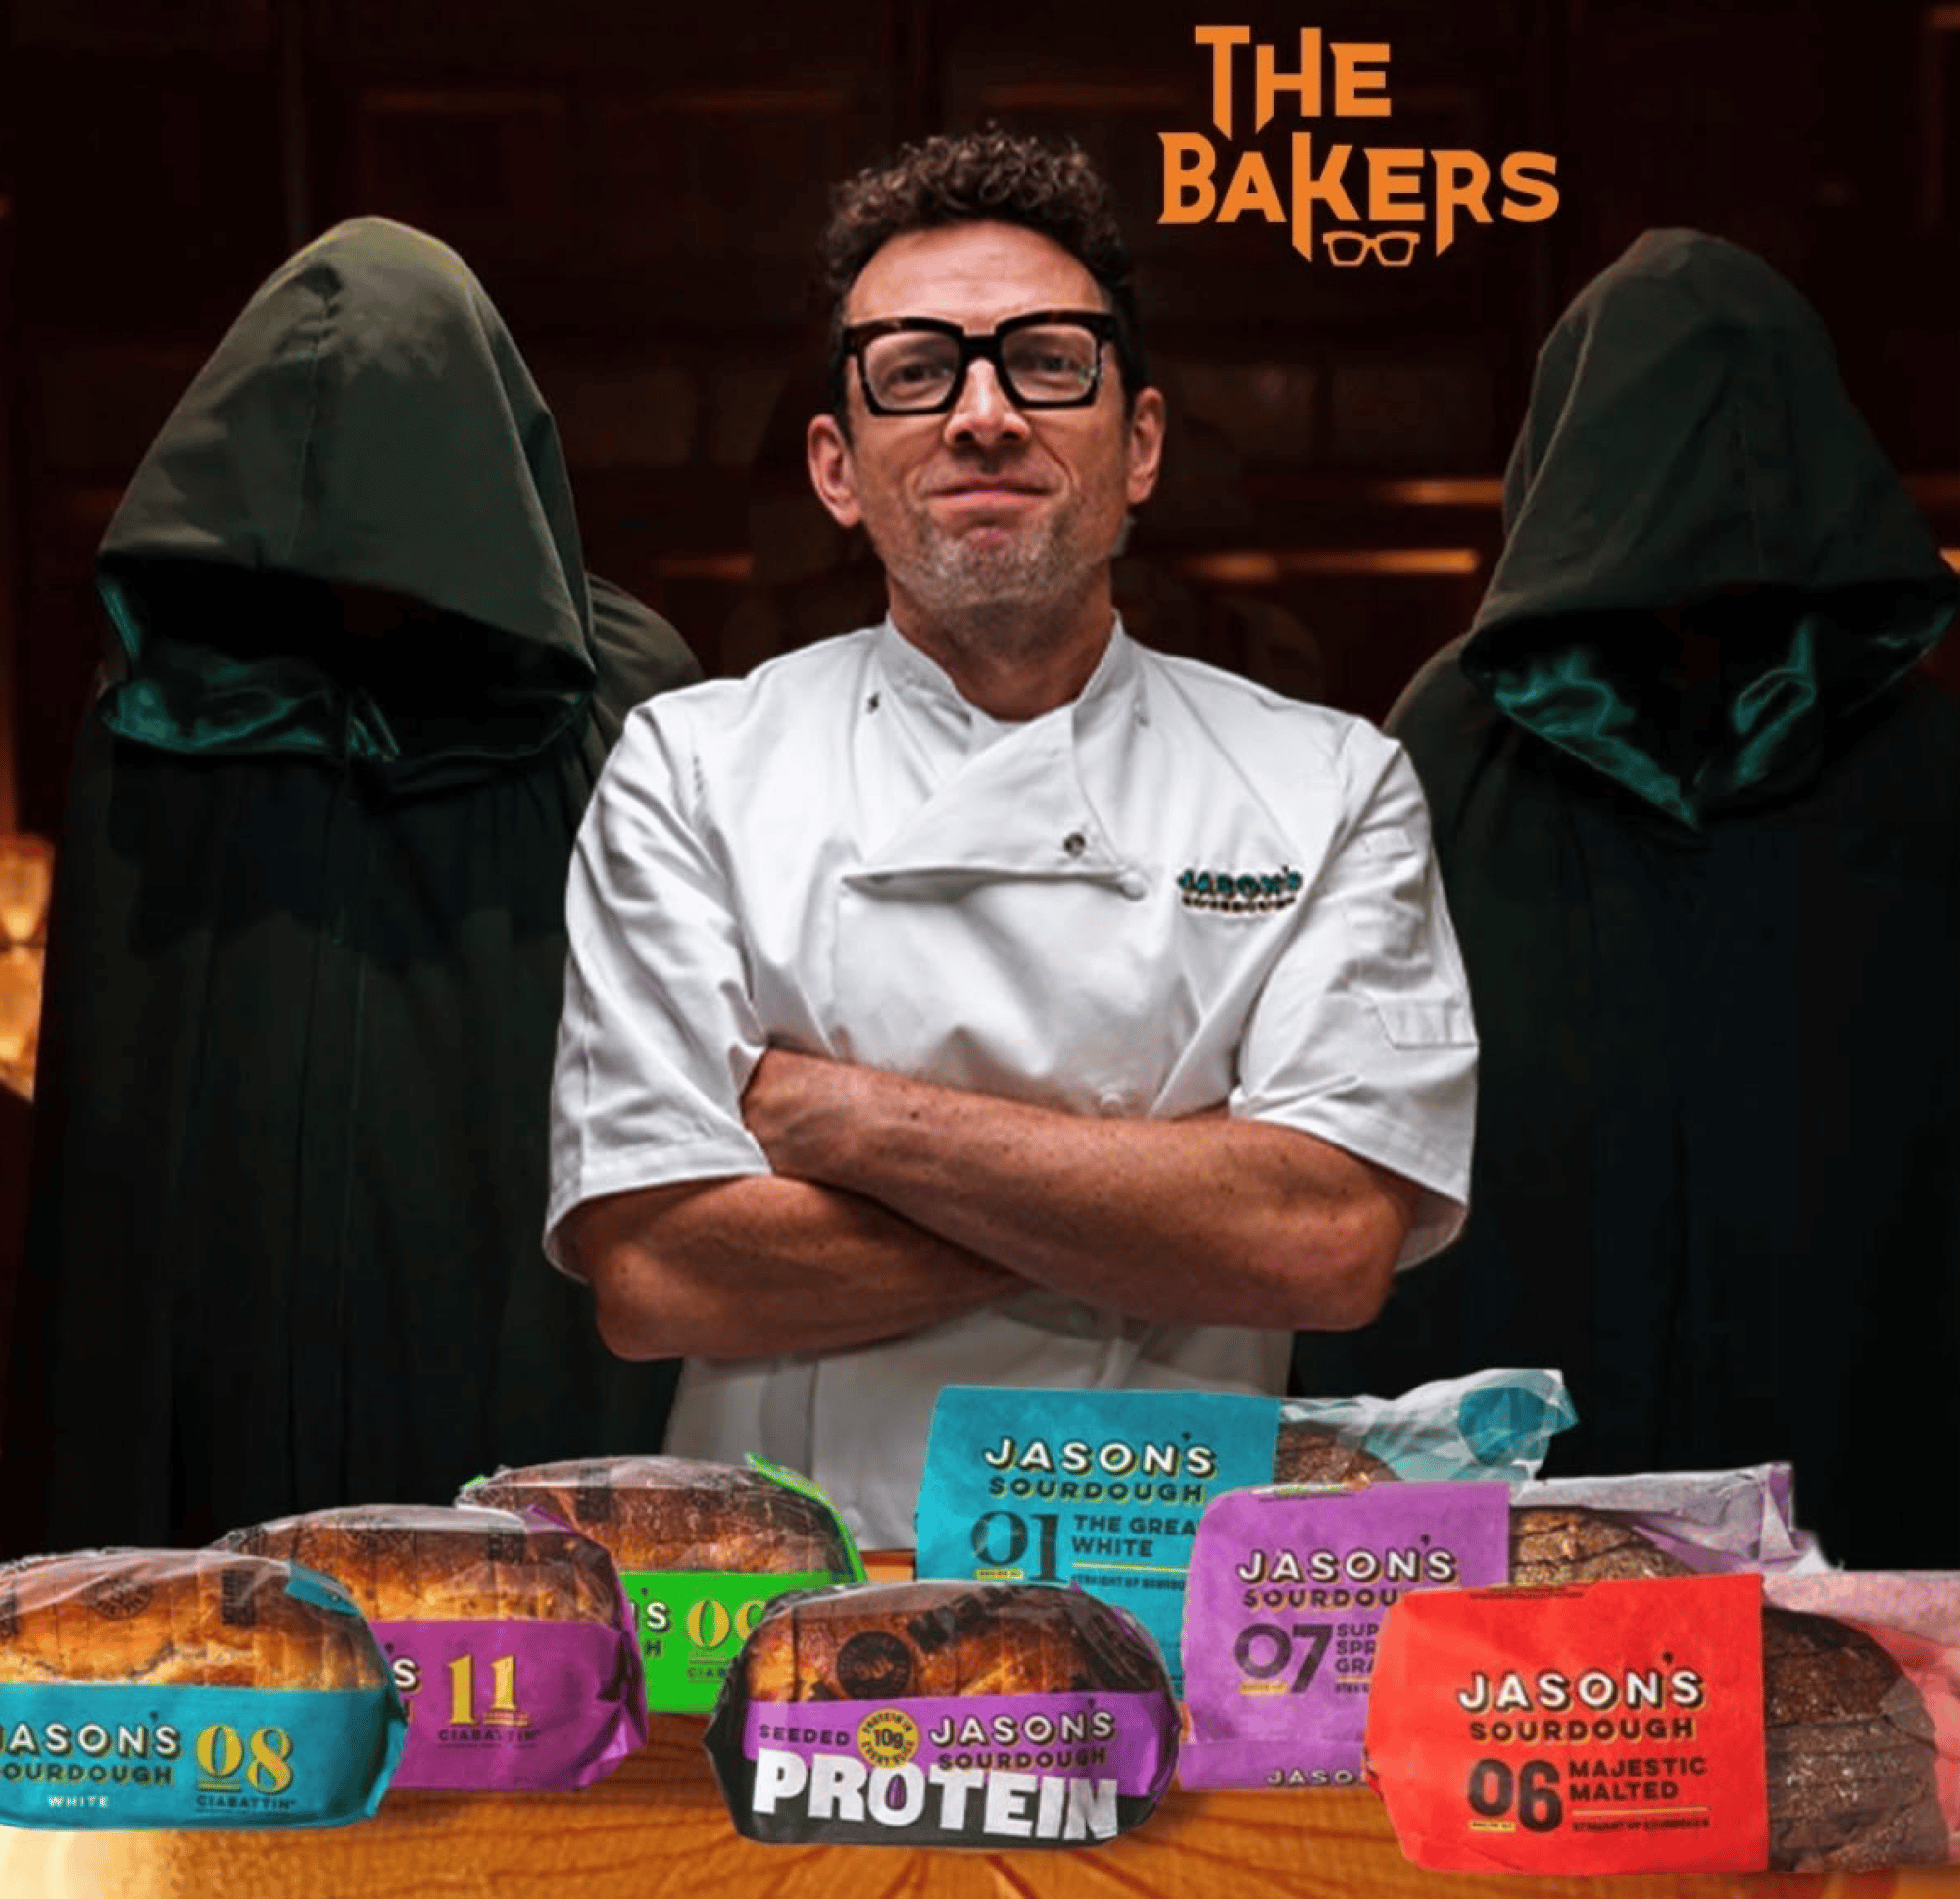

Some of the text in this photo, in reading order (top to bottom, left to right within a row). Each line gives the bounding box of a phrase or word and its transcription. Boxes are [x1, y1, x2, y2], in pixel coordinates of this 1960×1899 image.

[984, 1432, 1216, 1478] JASON'S
[988, 1476, 1205, 1505] SOURDOUGH
[1072, 1514, 1122, 1534] THE
[970, 1510, 1069, 1583] 01
[1072, 1537, 1153, 1558] WHITE
[1237, 1534, 1459, 1584] JASON'S
[1242, 1588, 1400, 1609] SOURDOU
[1337, 1623, 1379, 1638] SUP
[1234, 1623, 1334, 1694] 07
[446, 1651, 519, 1726] 11
[1457, 1651, 1707, 1713] JASON'S
[0, 1711, 183, 1760] ASON'S
[760, 1723, 851, 1746] SEEDED
[929, 1698, 1118, 1748] JASON'S
[1471, 1718, 1697, 1744] SOURDOUGH
[196, 1724, 295, 1795] 08
[939, 1746, 1107, 1770] SOURDOUGH
[1569, 1757, 1708, 1778] MAJESTIC
[48, 1795, 109, 1808] WHITE
[753, 1748, 1118, 1840] PROTEIN
[1468, 1758, 1564, 1833] 06
[1570, 1781, 1679, 1802] MALTED
